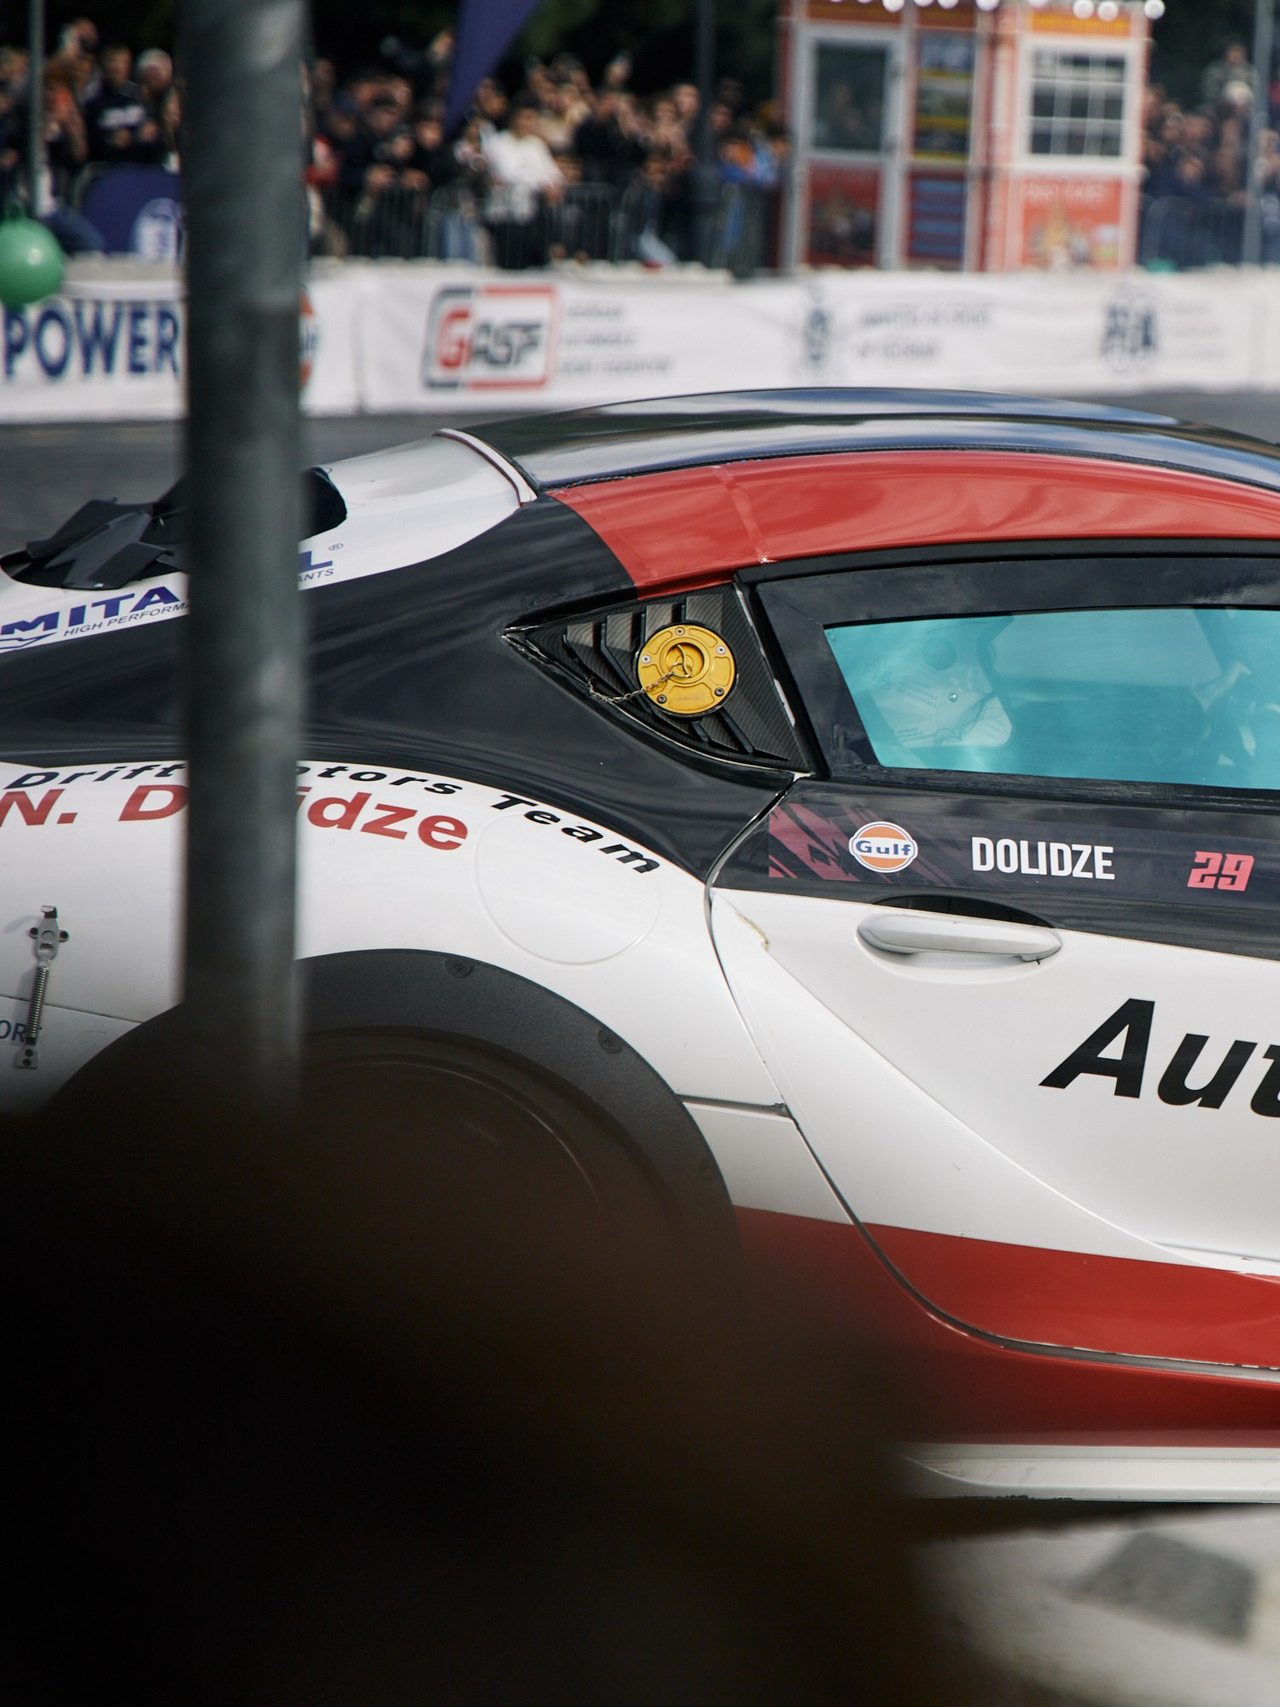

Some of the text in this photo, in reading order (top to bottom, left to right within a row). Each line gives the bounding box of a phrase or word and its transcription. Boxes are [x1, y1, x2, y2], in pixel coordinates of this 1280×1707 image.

[2, 302, 181, 377] POWER
[0, 586, 181, 635] MITA
[64, 601, 190, 637] HIGH PERFORM
[4, 763, 187, 789] Drift
[491, 794, 661, 874] Team
[856, 839, 911, 857] Gulf
[972, 836, 1115, 880] DOLIDZE
[1187, 851, 1255, 891] 29
